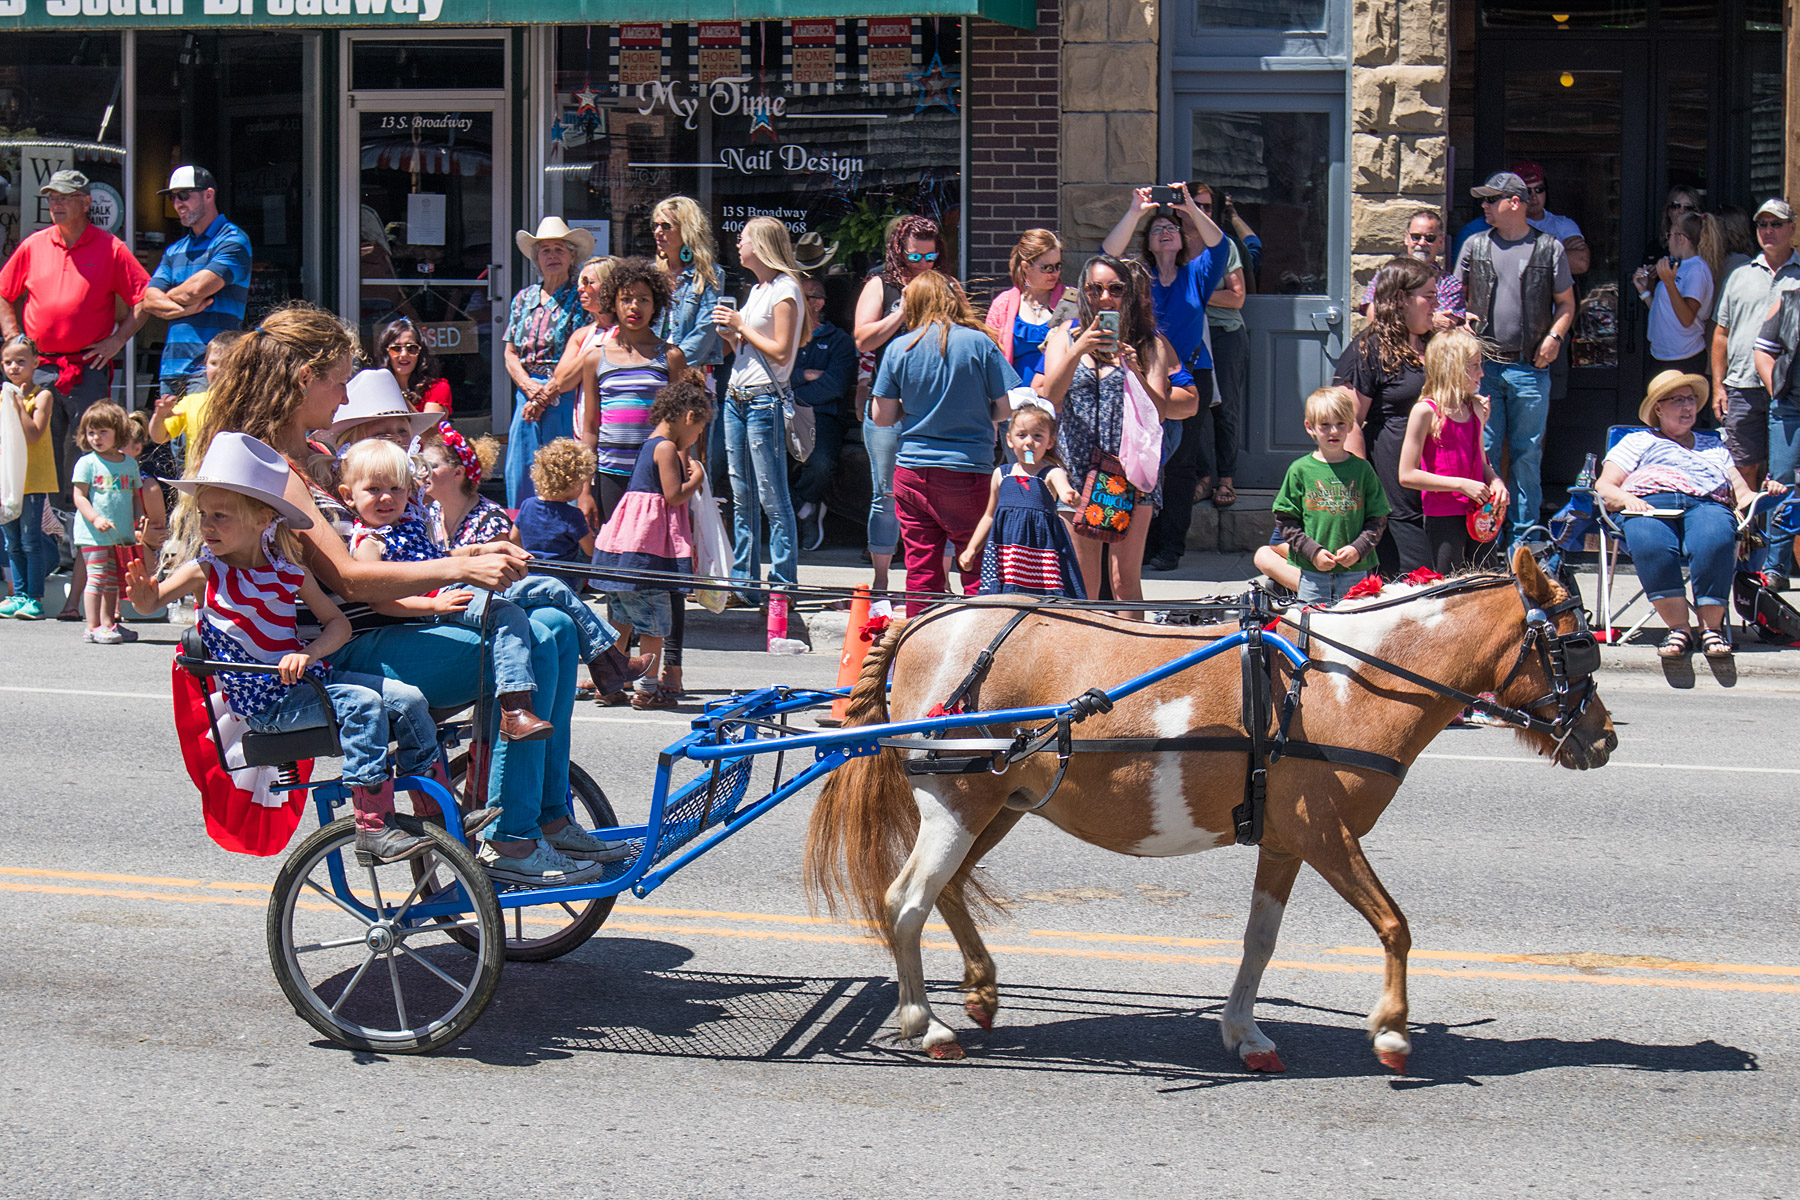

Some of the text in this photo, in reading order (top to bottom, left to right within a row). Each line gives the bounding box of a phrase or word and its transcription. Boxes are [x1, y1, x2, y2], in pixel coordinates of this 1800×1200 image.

[621, 27, 661, 39] AMERICA
[701, 26, 740, 38] AMERICA
[794, 25, 834, 37] AMERICA
[869, 24, 910, 36] AMERICA
[622, 52, 655, 63] HOME
[701, 51, 735, 62] HOME
[795, 50, 830, 61] HOME
[871, 50, 906, 61] HOME
[629, 63, 652, 71] of the
[708, 62, 732, 70] of the
[813, 61, 826, 69] the
[878, 61, 902, 69] of the
[621, 72, 659, 82] BRAVE
[795, 70, 833, 81] BRAVE
[637, 76, 787, 131] My Time
[381, 114, 473, 132] 13 S. Broadway
[720, 144, 864, 181] Nail Design
[89, 205, 111, 216] HALK
[722, 205, 808, 221] 13 S Broadway
[90, 216, 110, 226] AINT
[426, 326, 461, 348] SED
